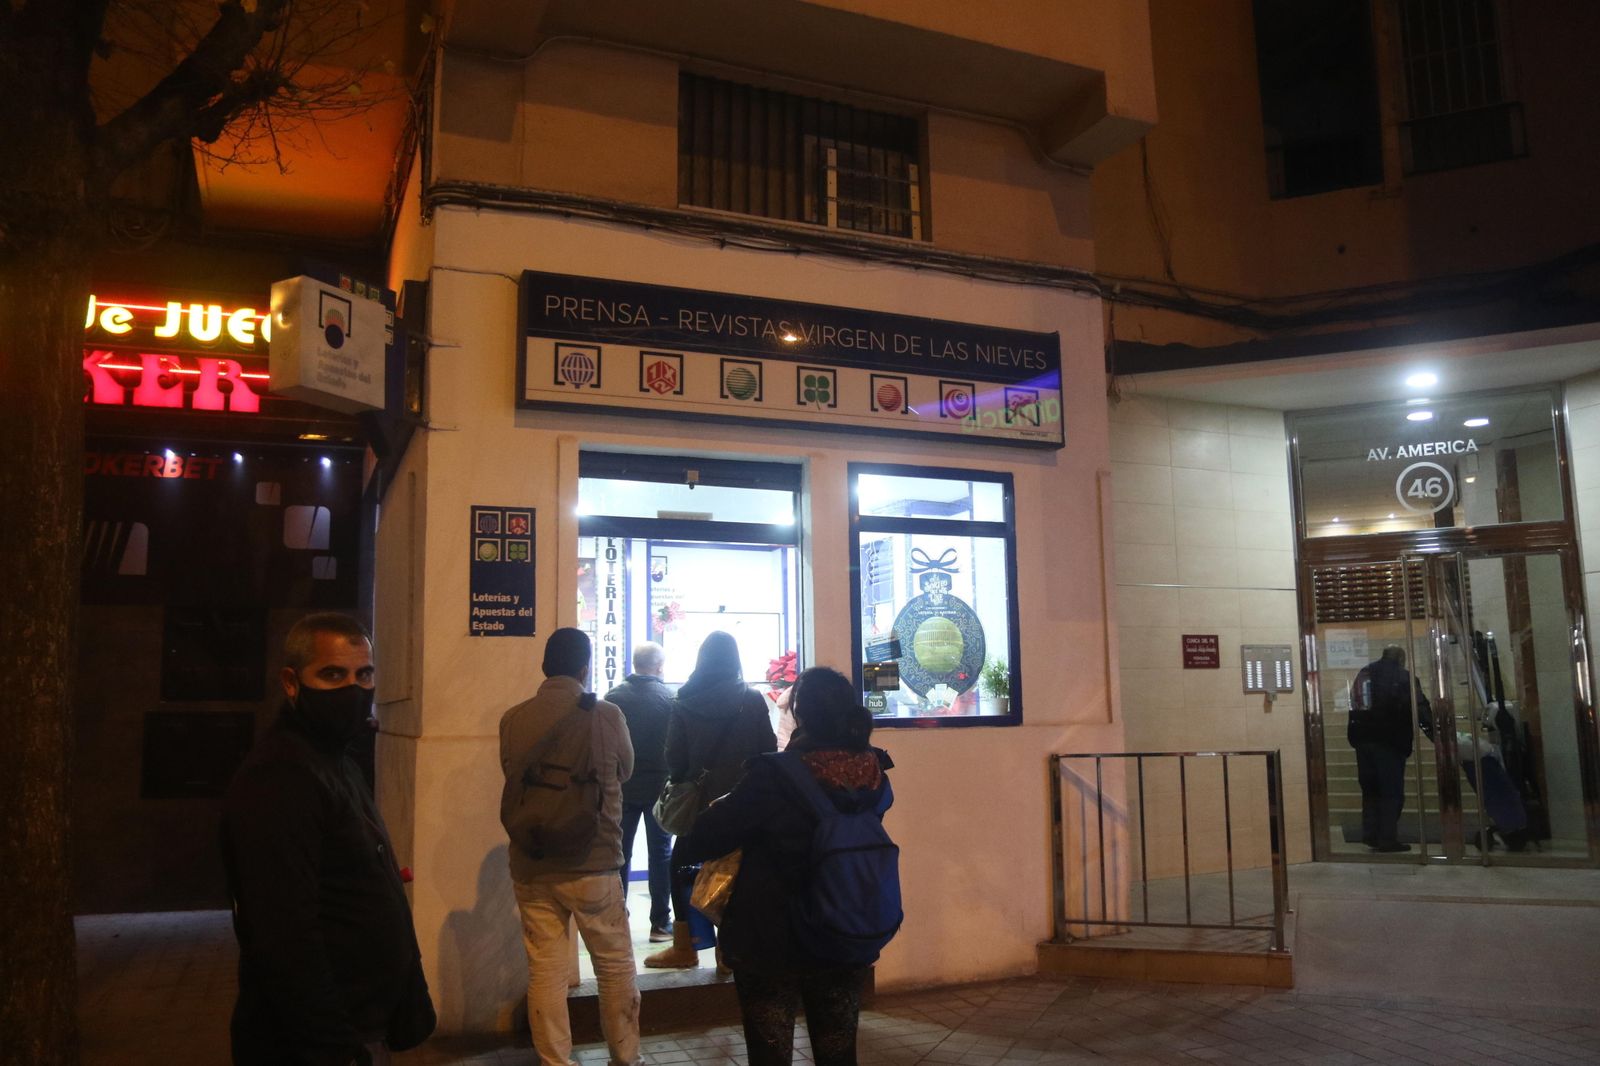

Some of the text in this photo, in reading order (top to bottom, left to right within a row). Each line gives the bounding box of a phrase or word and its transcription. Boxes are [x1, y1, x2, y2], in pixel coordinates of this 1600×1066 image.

[544, 295, 650, 326] PRENSA
[679, 309, 792, 341] REVISTAS
[800, 323, 885, 351] VIRGEN
[894, 334, 923, 356] DE
[930, 338, 969, 361] LAS
[976, 344, 1047, 370] NIEVES
[1367, 439, 1479, 461] AV. AMERICA
[1408, 477, 1443, 499] 46
[605, 537, 617, 625] LOTERIA
[473, 592, 520, 605] Loterías y
[472, 607, 533, 618] Apuestas del
[472, 620, 505, 630] Estado
[604, 632, 616, 642] de
[868, 699, 884, 708] hub
